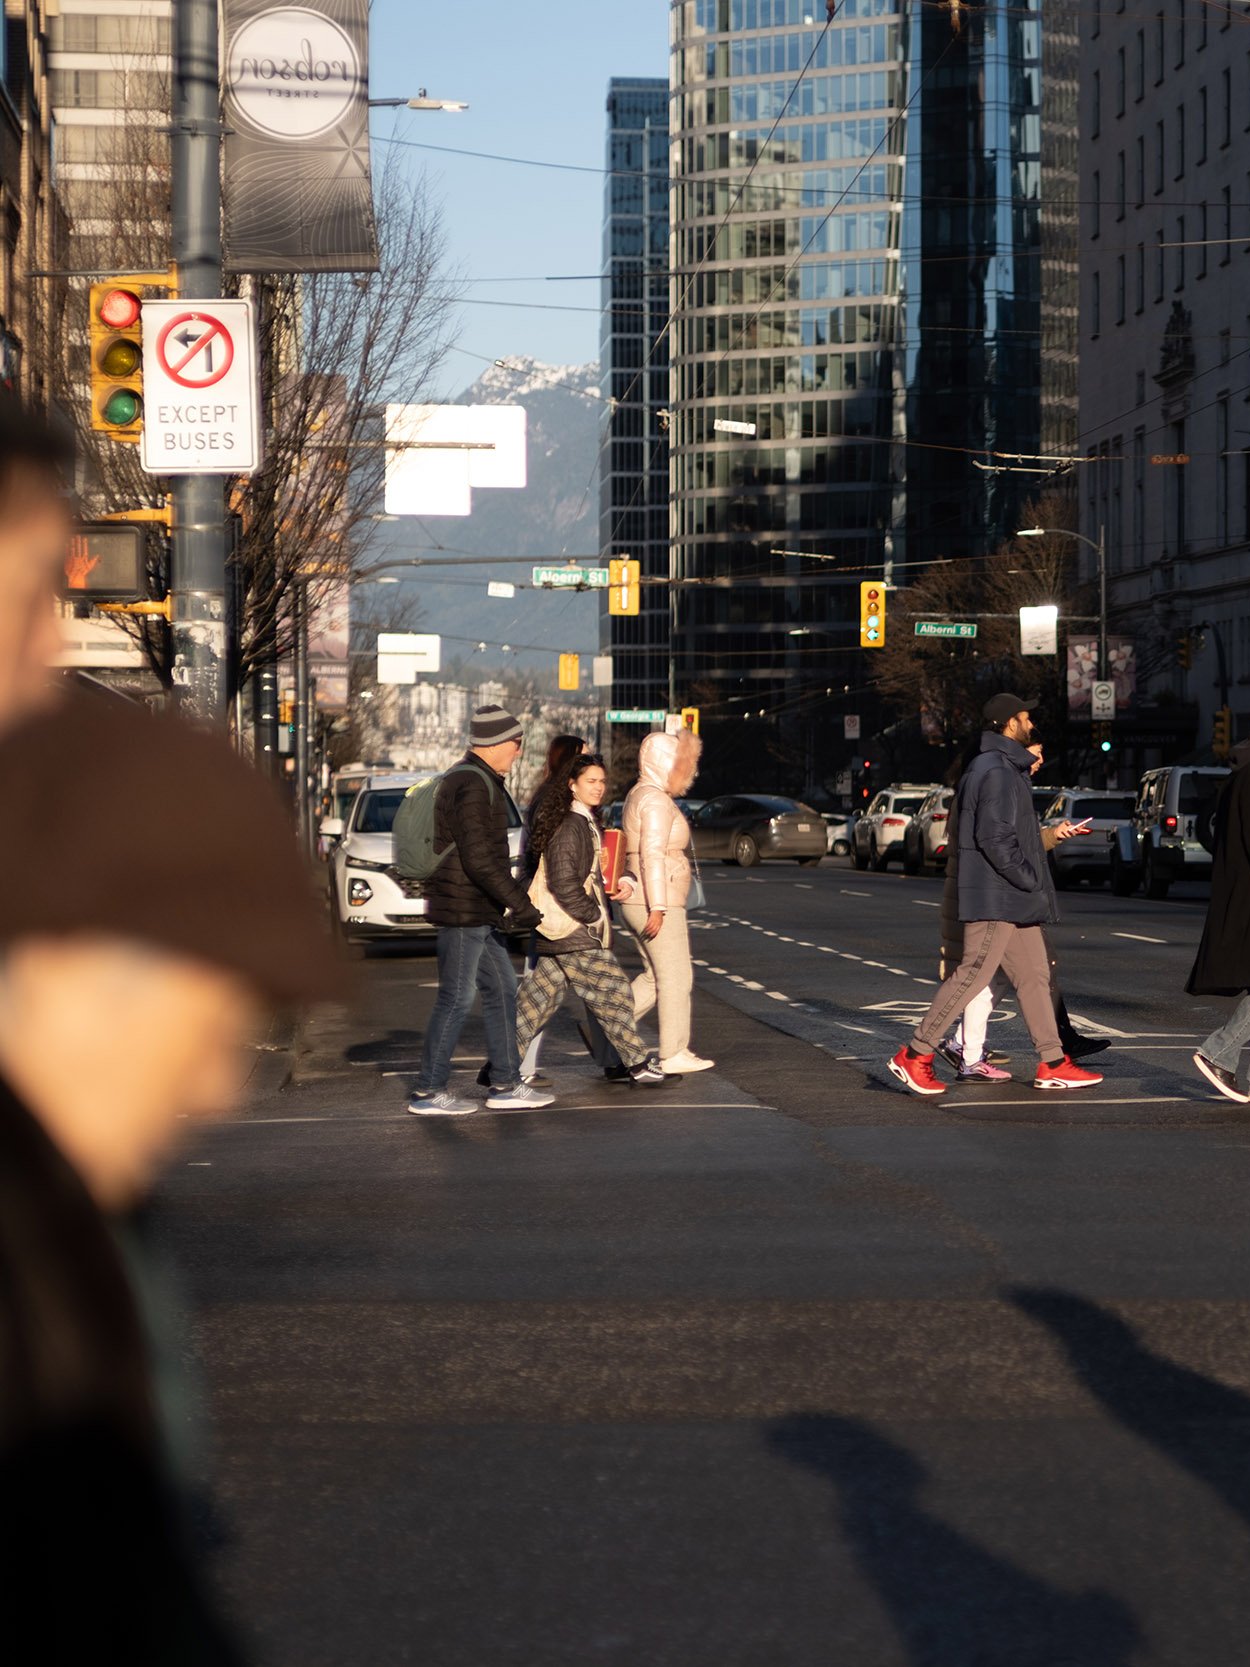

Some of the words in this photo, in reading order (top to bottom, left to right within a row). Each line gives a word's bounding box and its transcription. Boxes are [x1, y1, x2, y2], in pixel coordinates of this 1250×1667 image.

[158, 405, 238, 424] EXCEPT
[164, 432, 235, 450] BUSES
[588, 571, 603, 583] St
[919, 624, 956, 635] Alberni
[959, 626, 972, 635] St
[310, 664, 347, 675] ALBERNI
